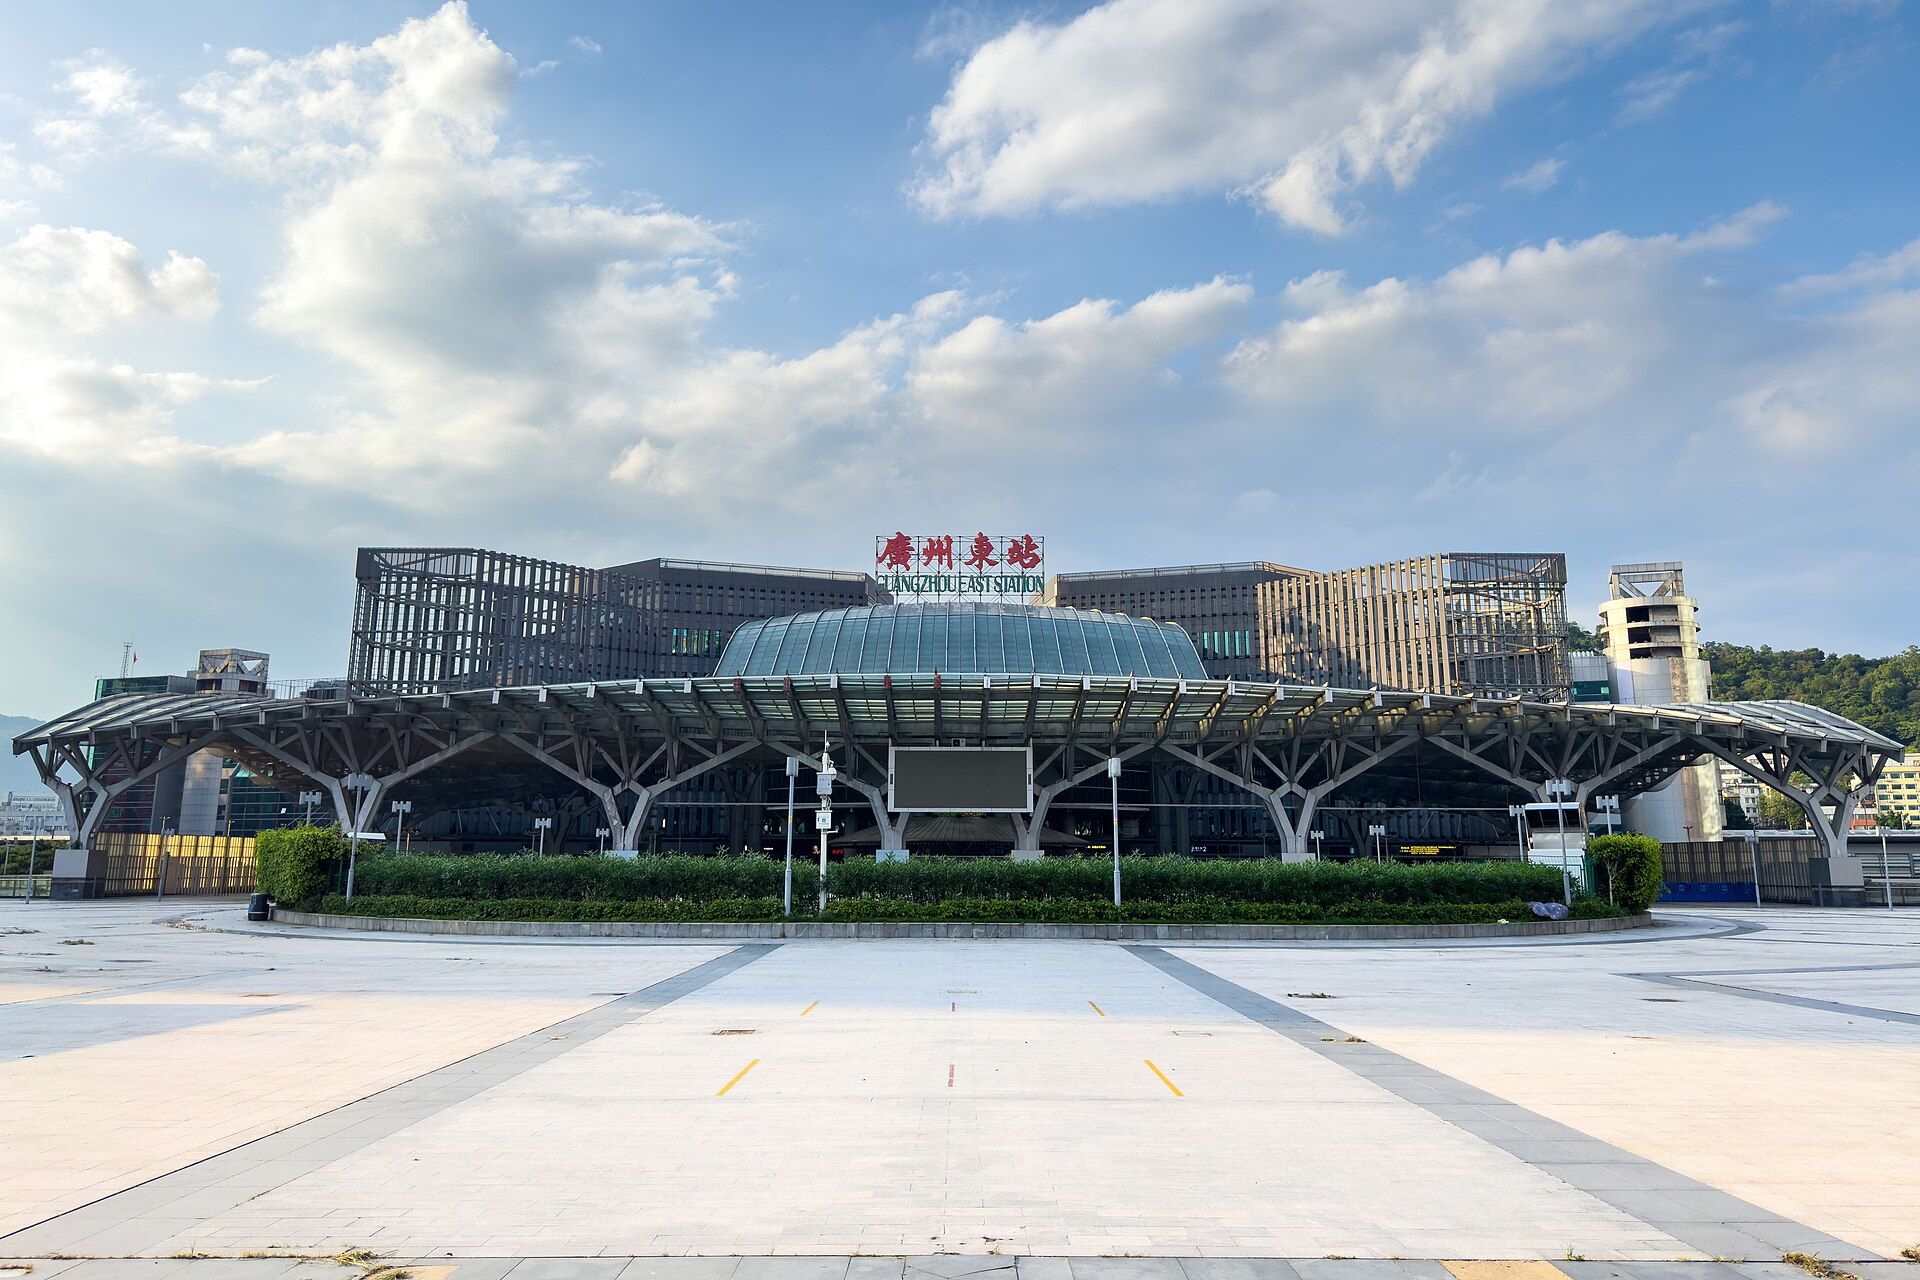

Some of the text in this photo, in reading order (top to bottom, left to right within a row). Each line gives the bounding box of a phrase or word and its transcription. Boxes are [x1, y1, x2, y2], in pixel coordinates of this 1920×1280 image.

[877, 531, 1041, 571] 廣州東站
[876, 575, 1044, 593] GUANGZHOU EAST STATION
